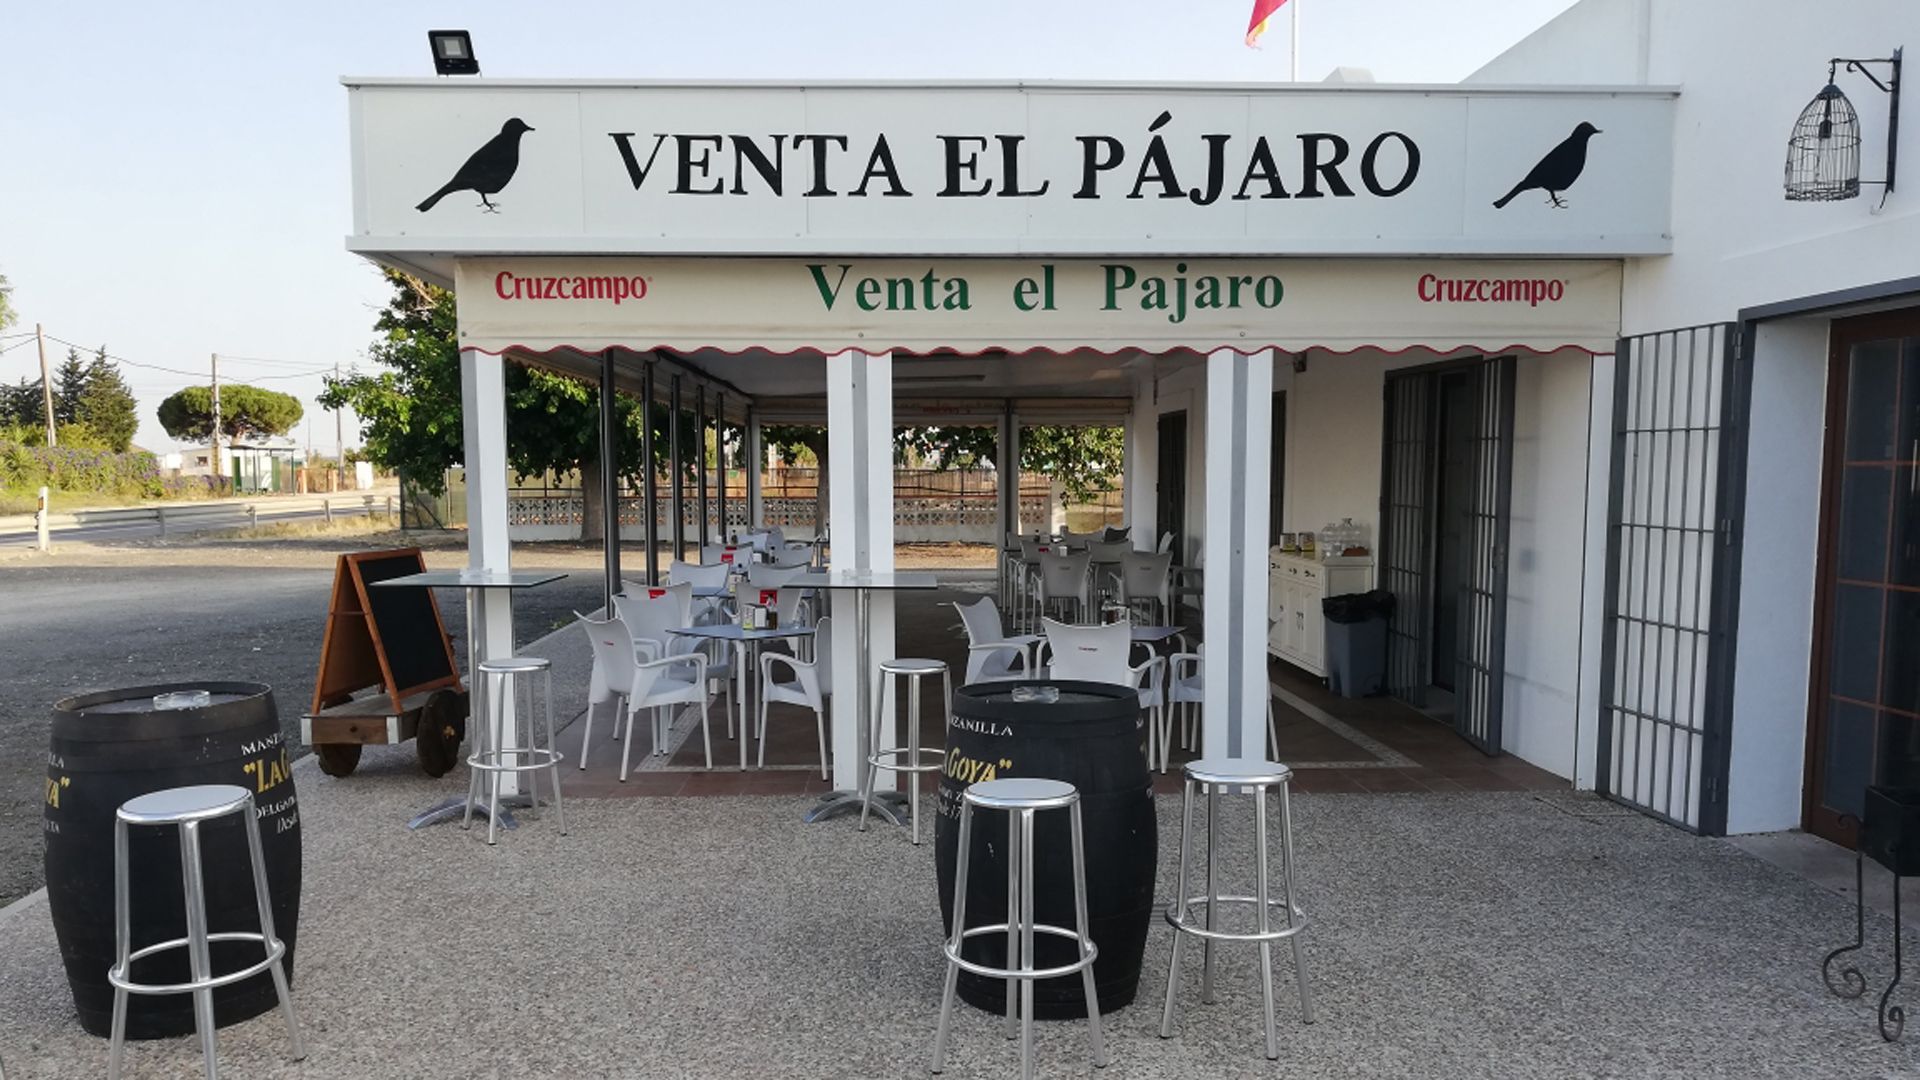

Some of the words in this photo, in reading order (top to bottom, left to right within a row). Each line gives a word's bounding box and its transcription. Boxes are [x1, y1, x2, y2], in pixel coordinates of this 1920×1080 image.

[608, 132, 913, 198] VENTA
[935, 134, 1051, 198] EL
[1072, 110, 1421, 206] PÁJARO
[495, 270, 648, 305] Cruzcampo
[806, 264, 972, 311] Venta
[1013, 264, 1058, 311] el
[1100, 262, 1285, 324] Pajaro
[1418, 273, 1564, 307] Cruzcampo
